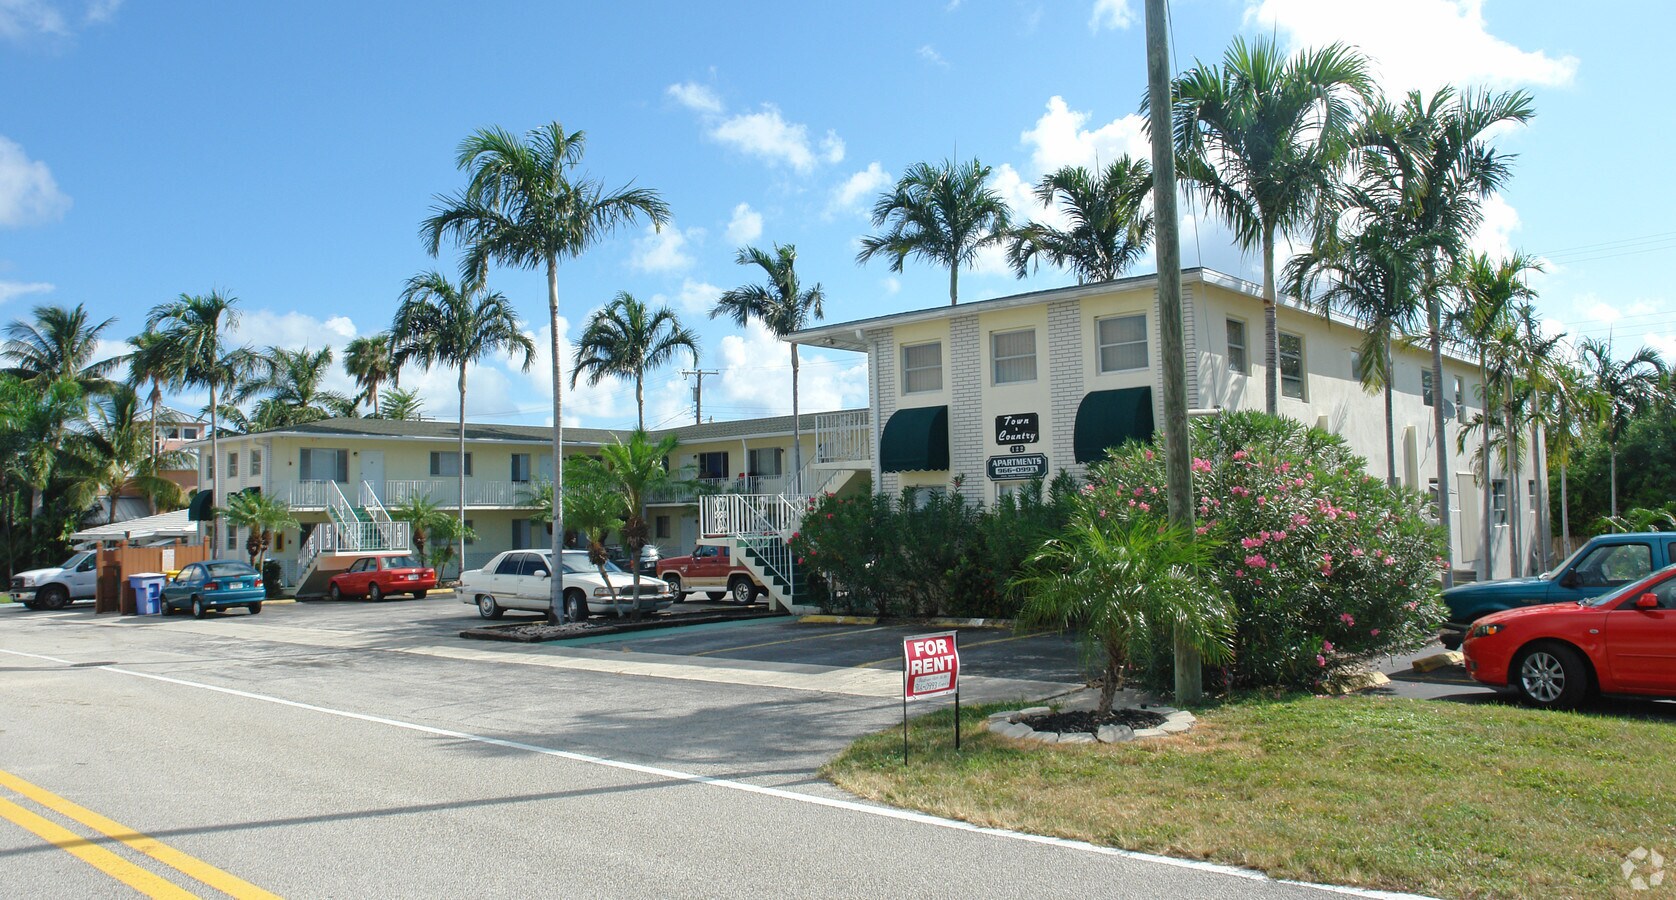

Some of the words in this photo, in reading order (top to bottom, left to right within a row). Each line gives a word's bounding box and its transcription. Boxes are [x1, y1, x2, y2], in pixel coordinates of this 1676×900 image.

[1004, 416, 1029, 425] Town
[999, 430, 1036, 442] Country
[992, 457, 1042, 467] APARTMENTS
[914, 639, 948, 657] FOR
[911, 655, 954, 675] RENT
